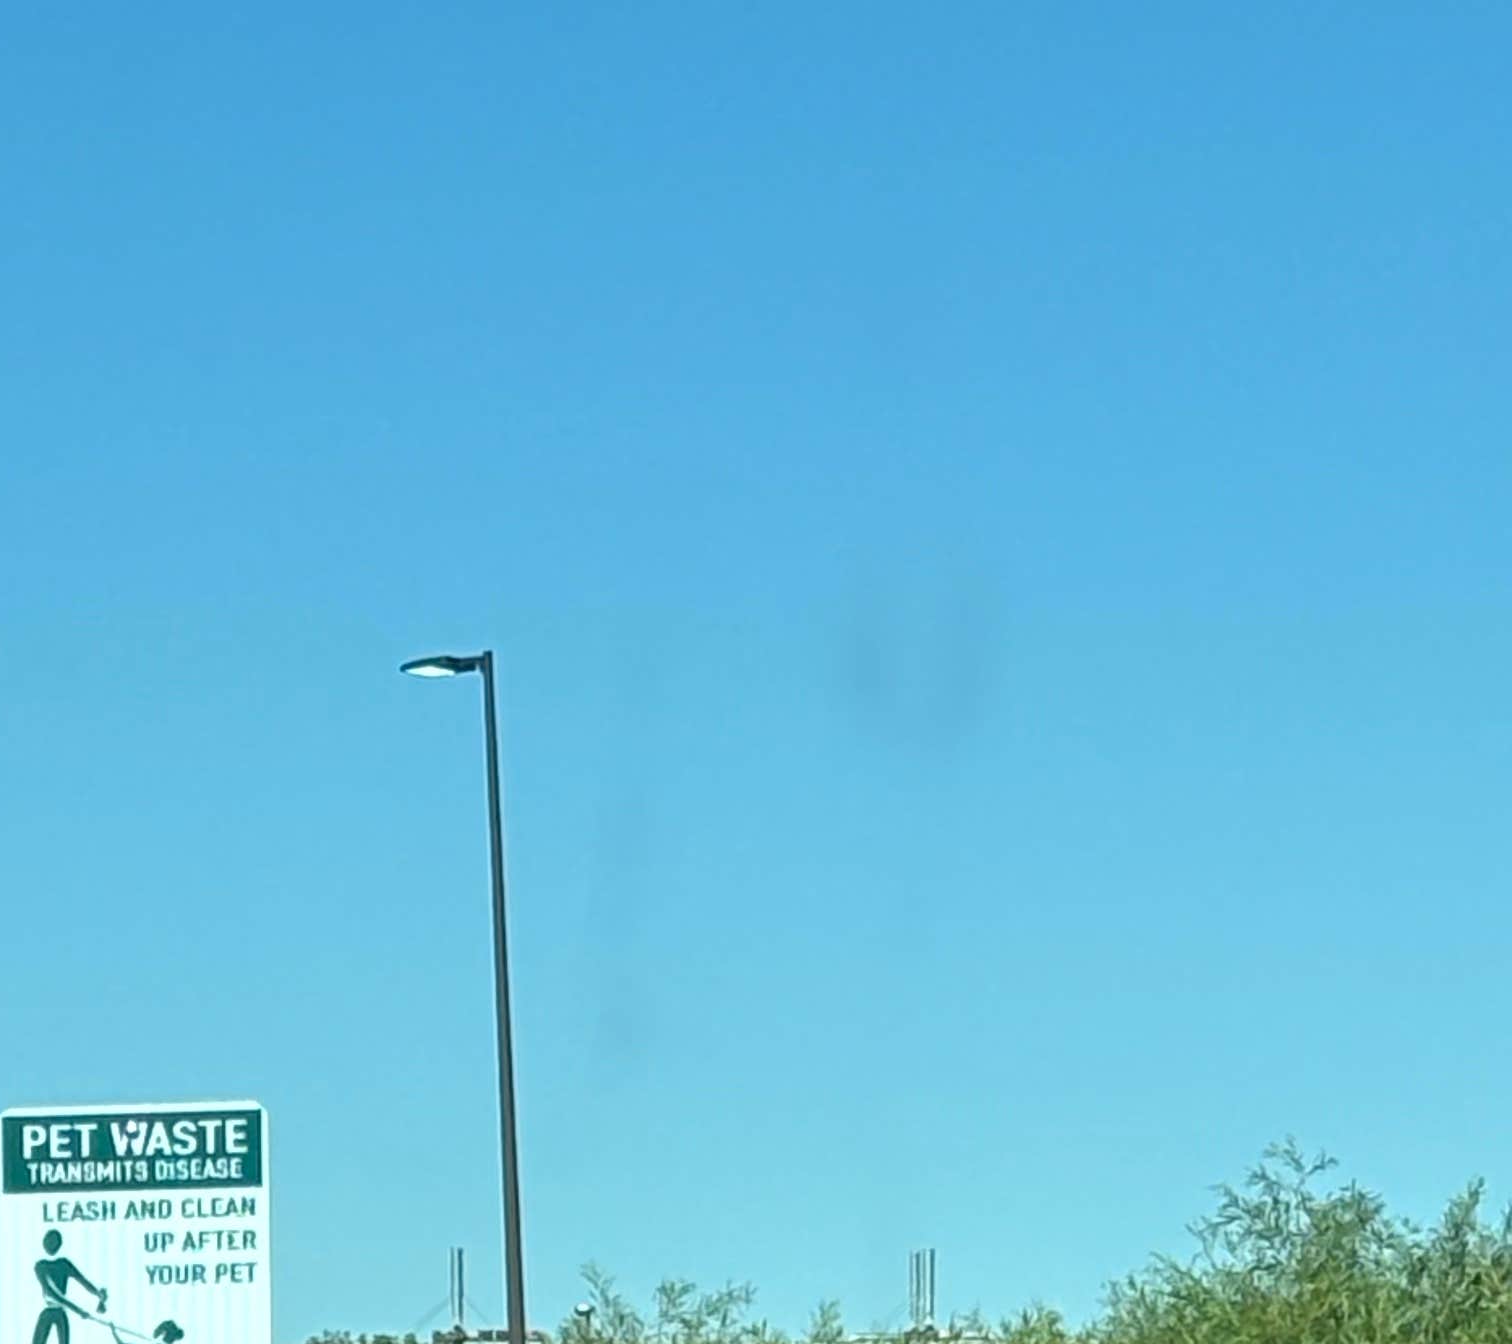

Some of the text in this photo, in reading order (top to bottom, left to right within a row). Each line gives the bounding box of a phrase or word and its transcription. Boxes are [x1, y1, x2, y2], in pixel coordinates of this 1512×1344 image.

[21, 1119, 249, 1160] PET WASTE
[26, 1158, 243, 1185] TRANSMITS DISEASE
[42, 1197, 256, 1223] LEASH AND CLEAN
[144, 1230, 257, 1253] UP AFTER
[145, 1262, 258, 1285] YOUR PET
